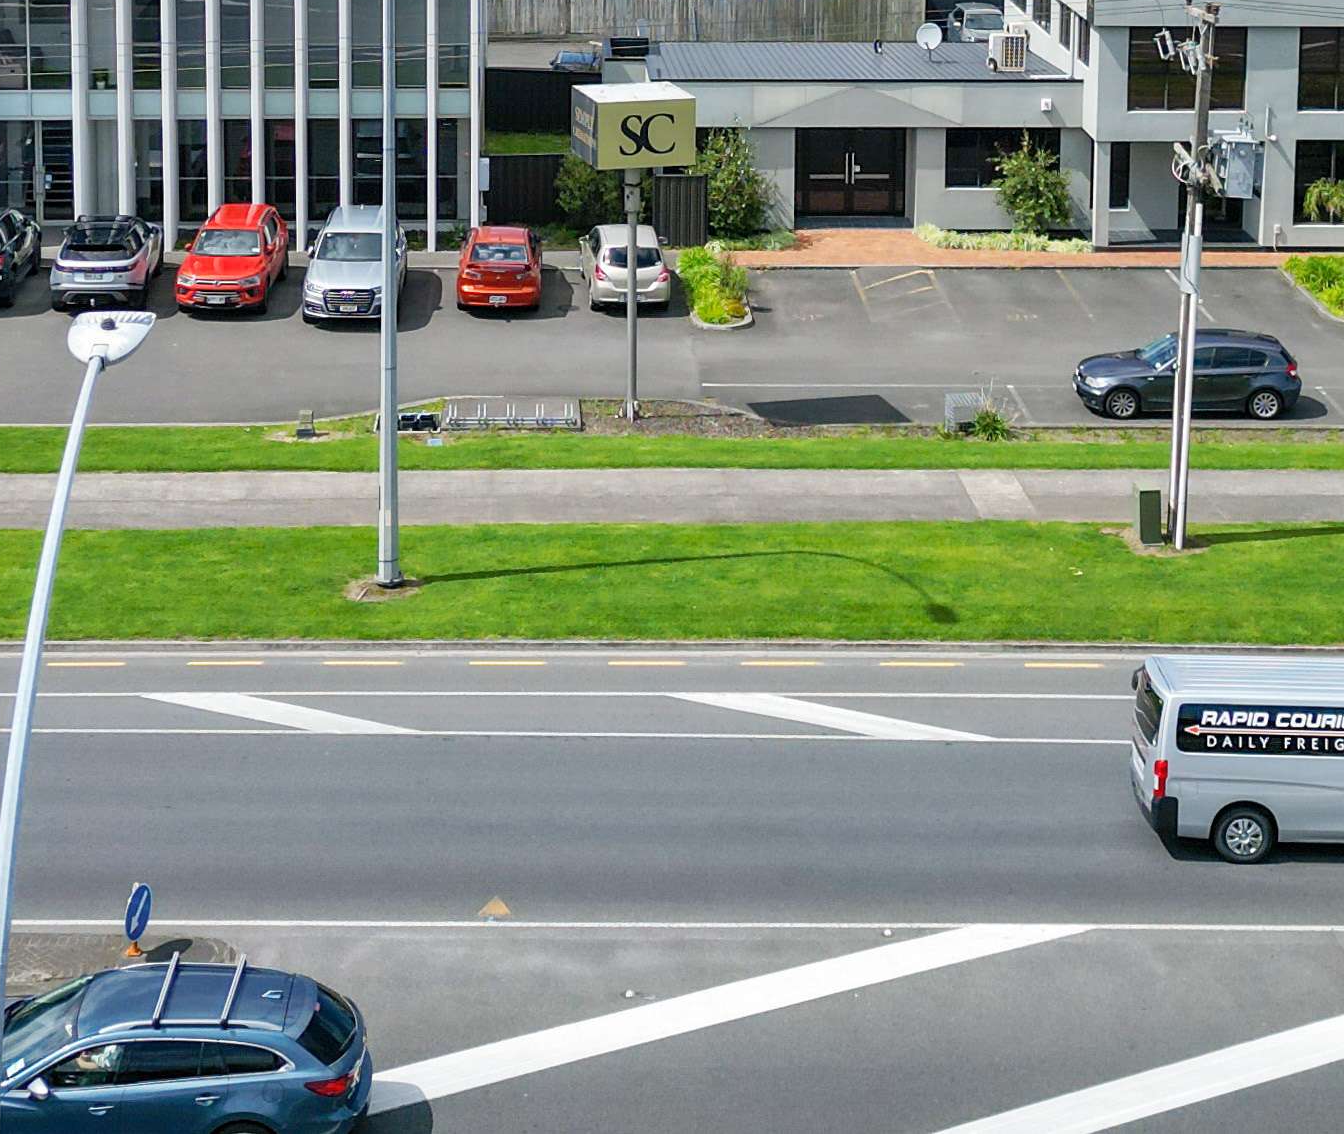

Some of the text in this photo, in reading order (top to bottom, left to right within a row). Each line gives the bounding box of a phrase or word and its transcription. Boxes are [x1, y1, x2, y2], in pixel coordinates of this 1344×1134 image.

[619, 113, 676, 156] SC
[1201, 710, 1269, 727] RAPID
[1206, 735, 1269, 749] DAILY
